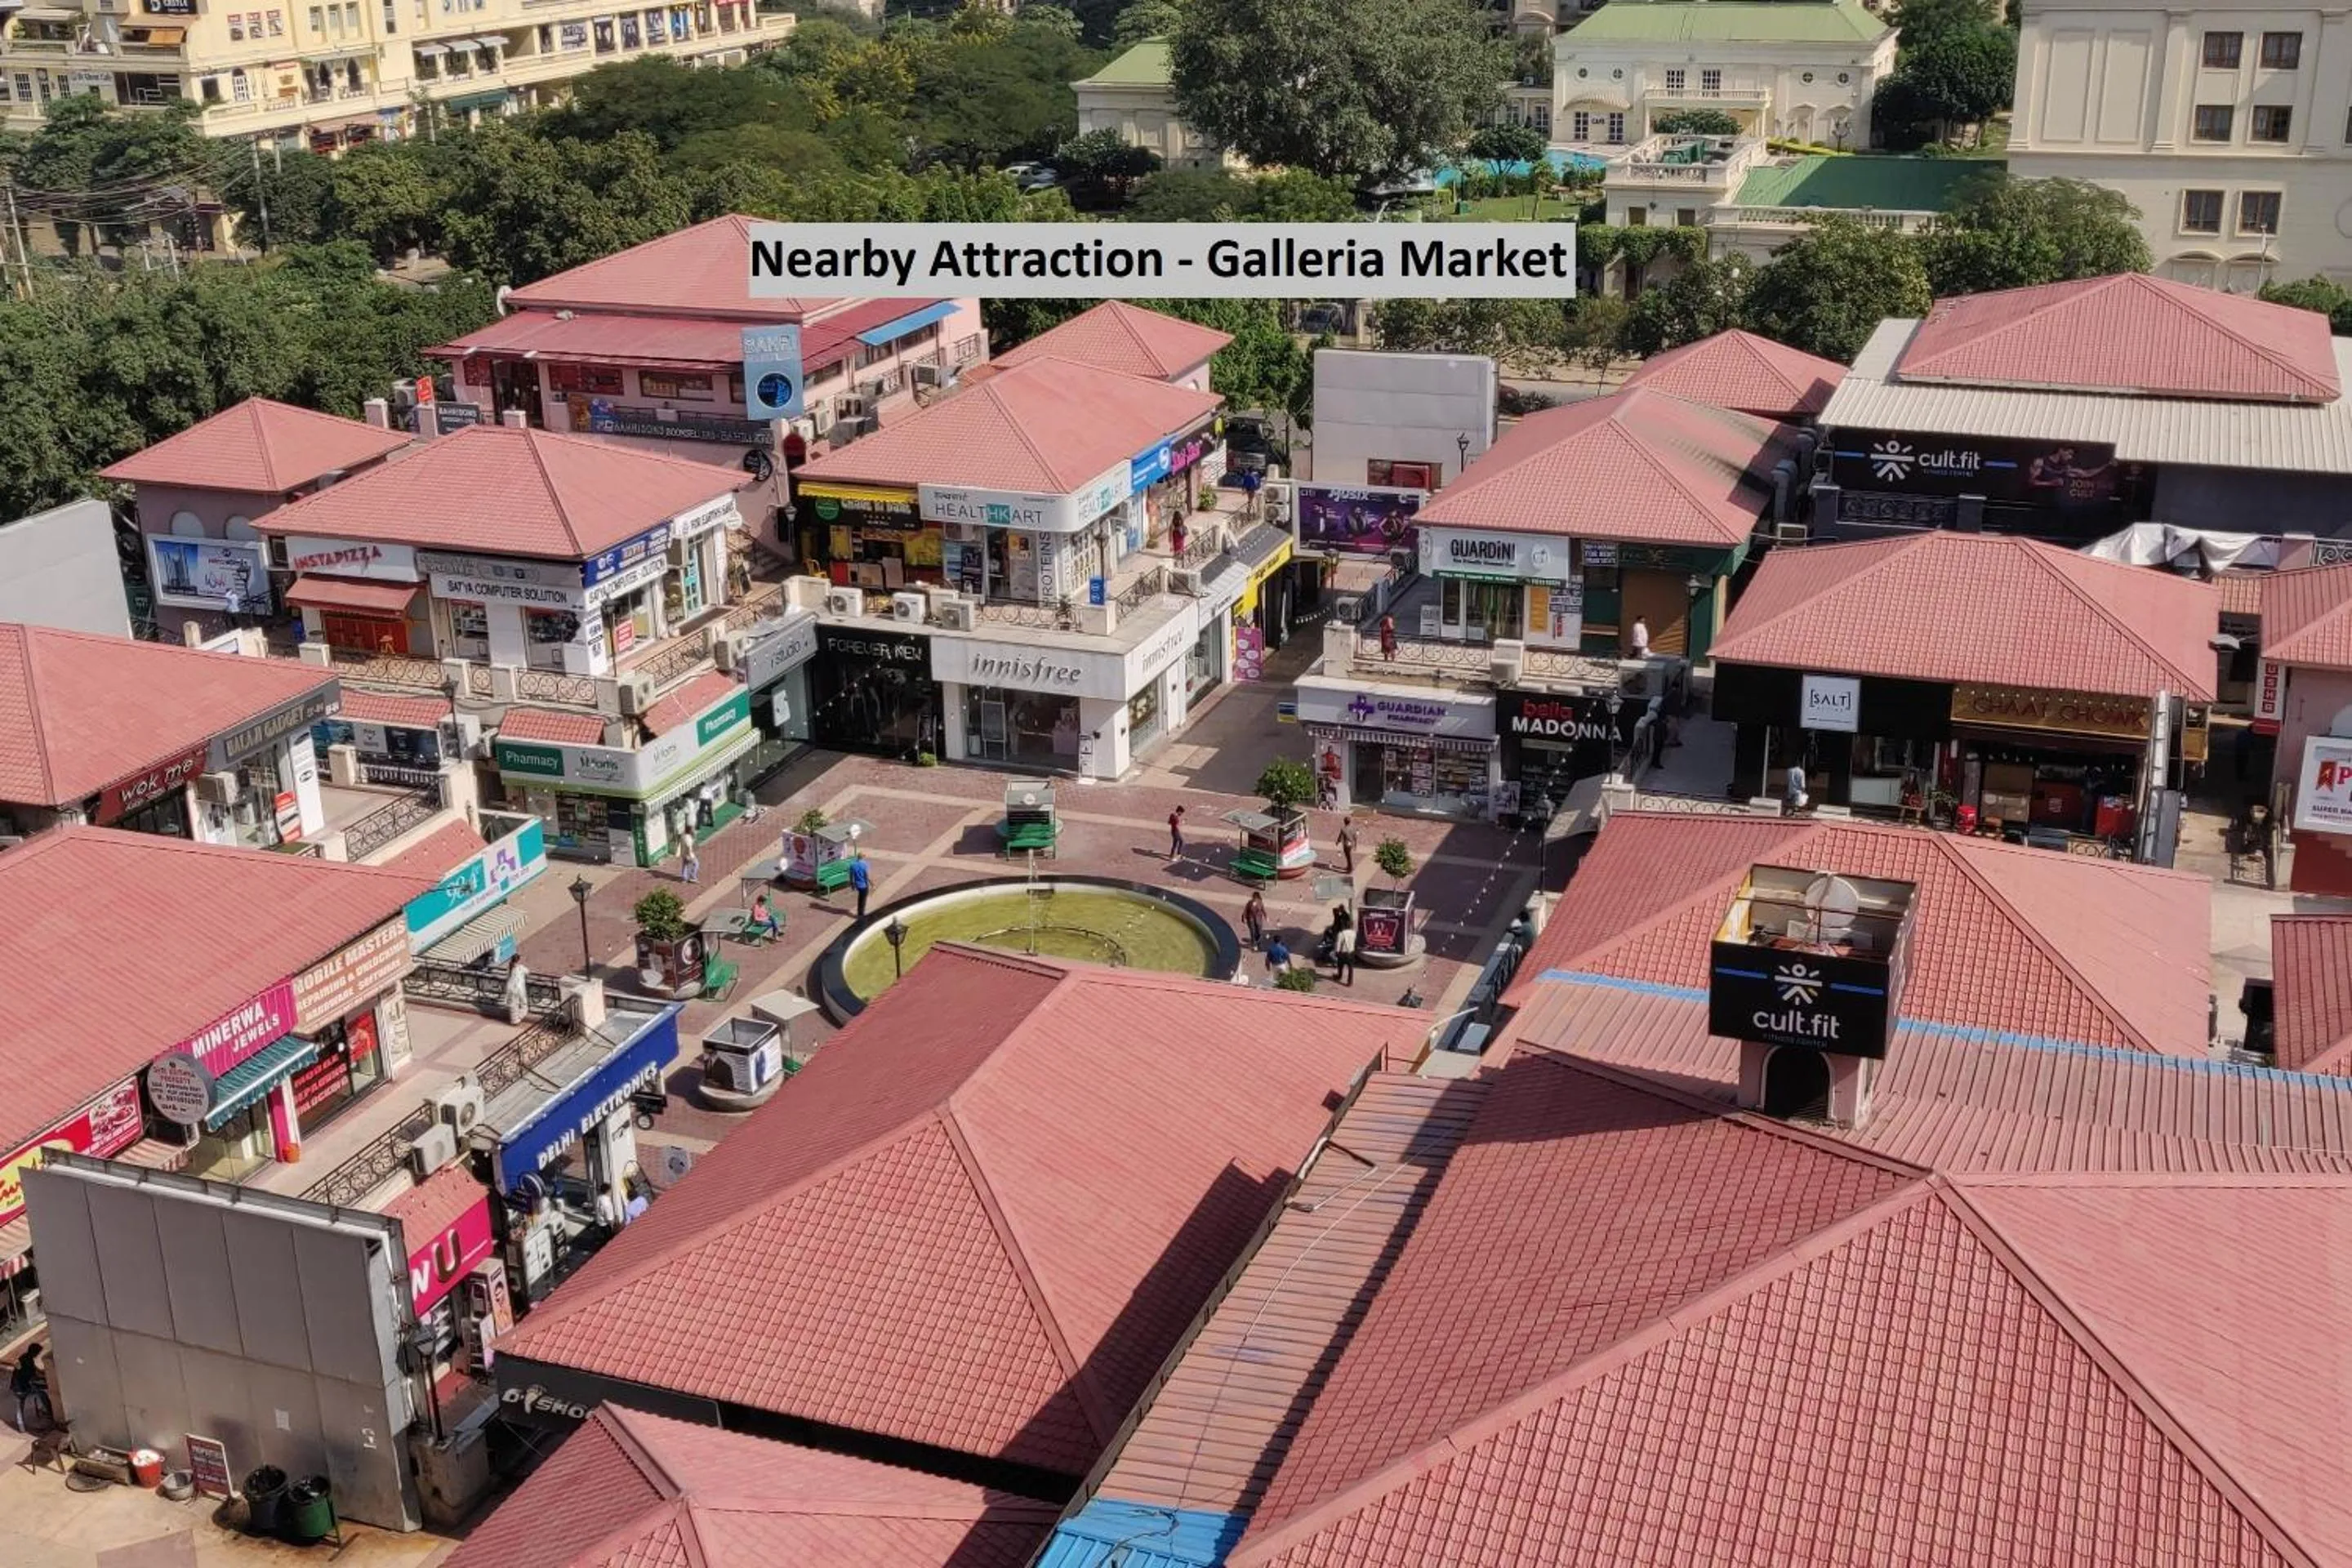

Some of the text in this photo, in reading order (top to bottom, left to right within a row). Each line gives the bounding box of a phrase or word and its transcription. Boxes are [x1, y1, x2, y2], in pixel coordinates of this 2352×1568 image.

[1919, 450, 1981, 470] cult.fit
[935, 504, 1042, 524] HEALTHKART
[448, 580, 567, 603] SATYA COMPUTER SOLUTION
[827, 637, 891, 660] FOREVER
[972, 653, 1081, 687] innisfree
[1378, 702, 1446, 716] GUARDIAN
[1512, 715, 1623, 742] MADONNA
[506, 750, 559, 769] Pharmacy
[120, 773, 159, 802] wok
[295, 922, 406, 992] MOBILE MASTERS
[191, 1001, 265, 1059] MINERWA
[232, 1013, 280, 1054] JEWELS
[1753, 1009, 1840, 1039] cult.fit
[537, 1062, 658, 1171] DELHI ELECTRONICS
